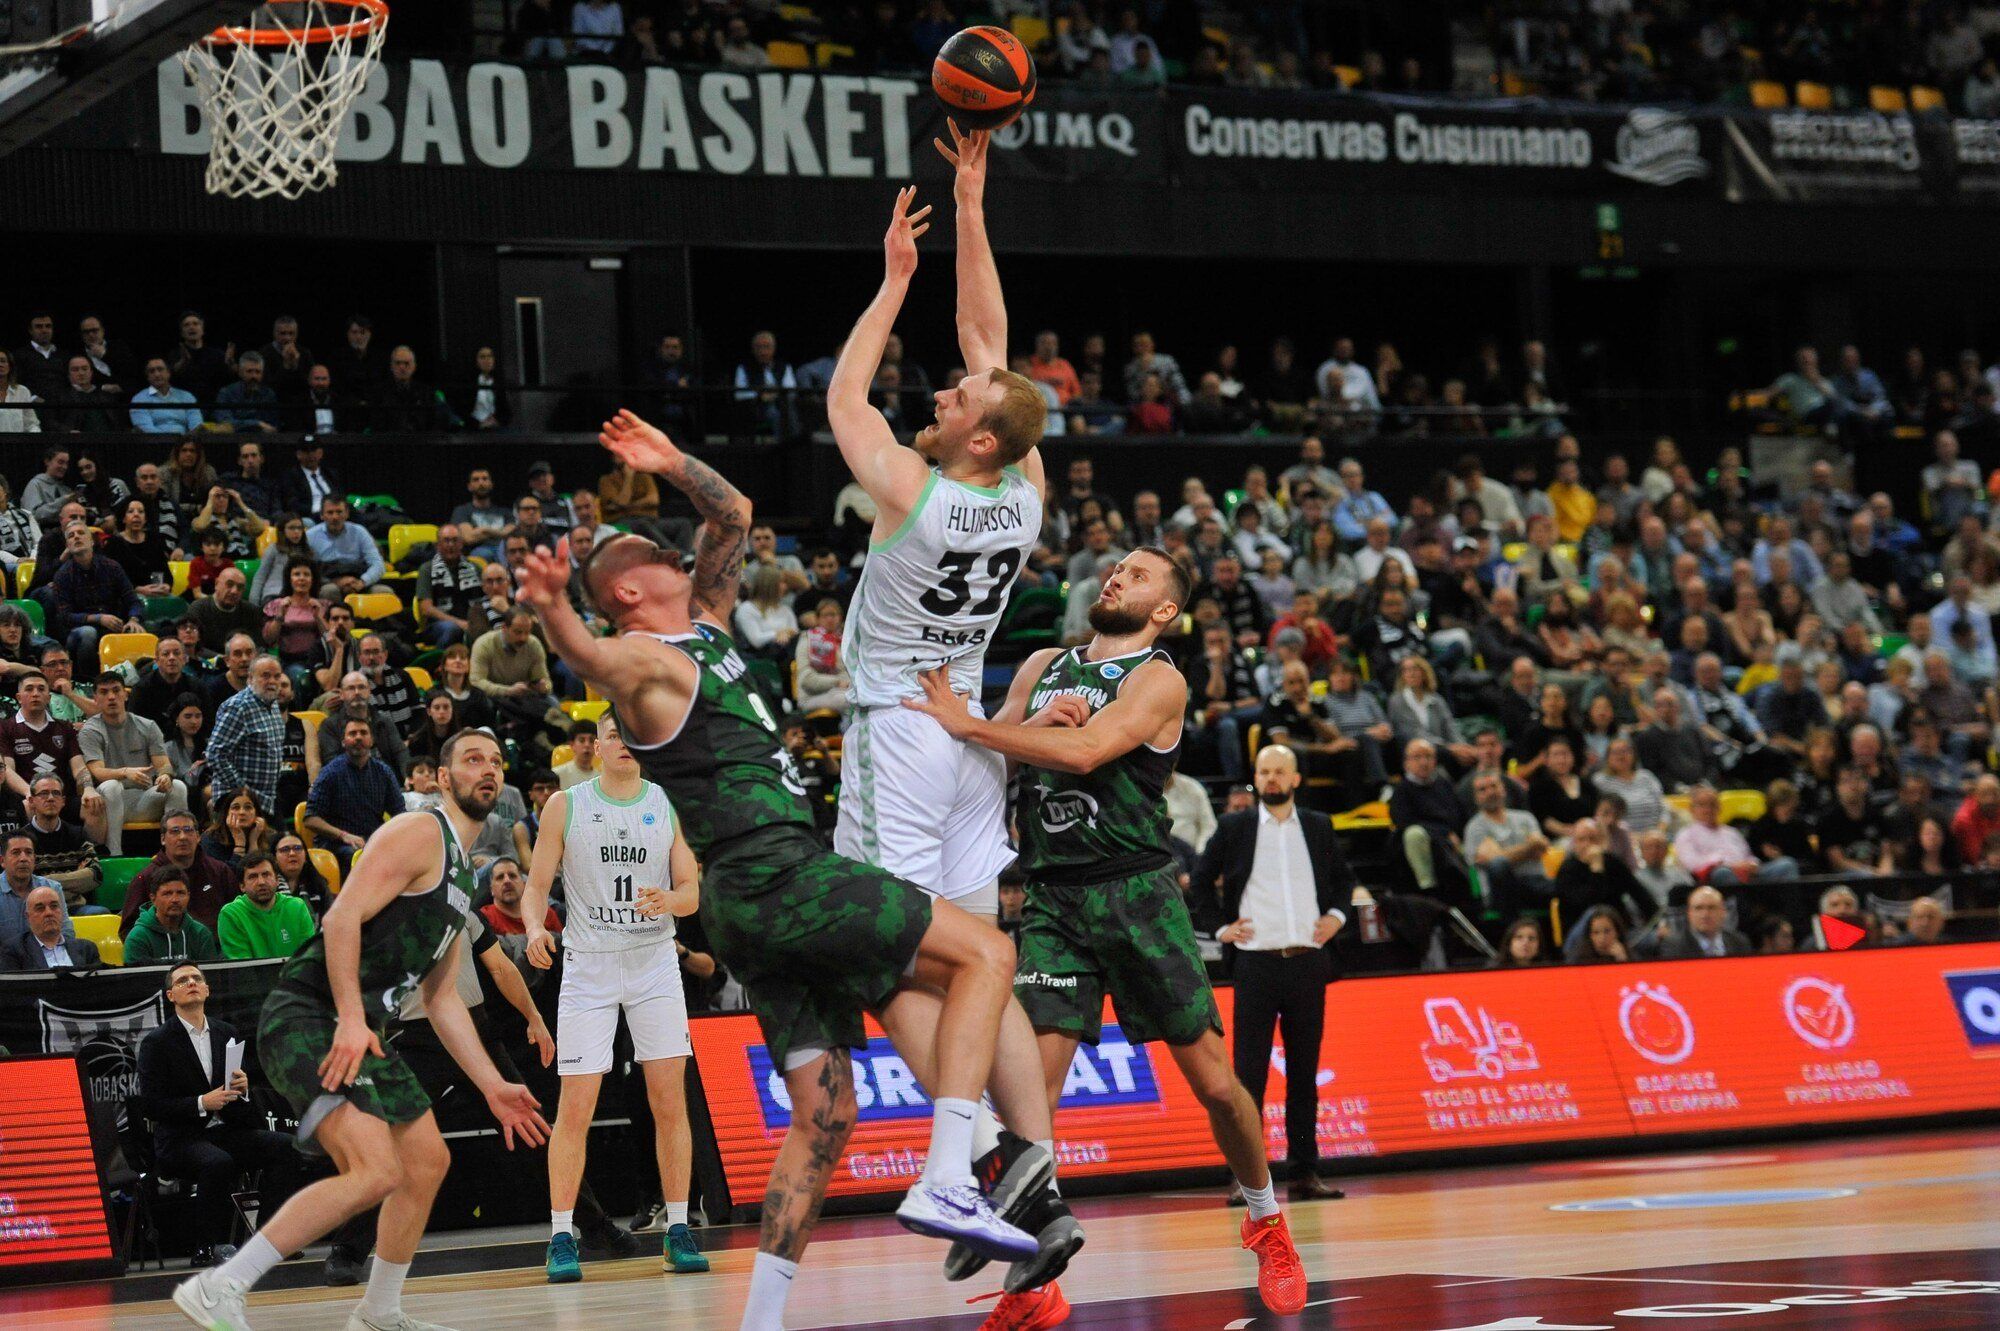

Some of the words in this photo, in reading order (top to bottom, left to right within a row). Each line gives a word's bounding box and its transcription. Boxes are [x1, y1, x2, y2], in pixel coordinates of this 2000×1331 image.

[566, 64, 919, 179] BASKET
[1033, 111, 1138, 156] IMQ
[1185, 104, 1388, 162] Conservas
[1394, 113, 1591, 168] Cusumano
[919, 547, 1021, 616] 32
[600, 845, 647, 864] BILBAO
[613, 874, 633, 902] 11
[1420, 1087, 1477, 1107] TODO
[1479, 1085, 1505, 1105] EL
[1507, 1082, 1571, 1103] STOCK
[1426, 1110, 1455, 1131] EN
[1458, 1108, 1484, 1128] EL
